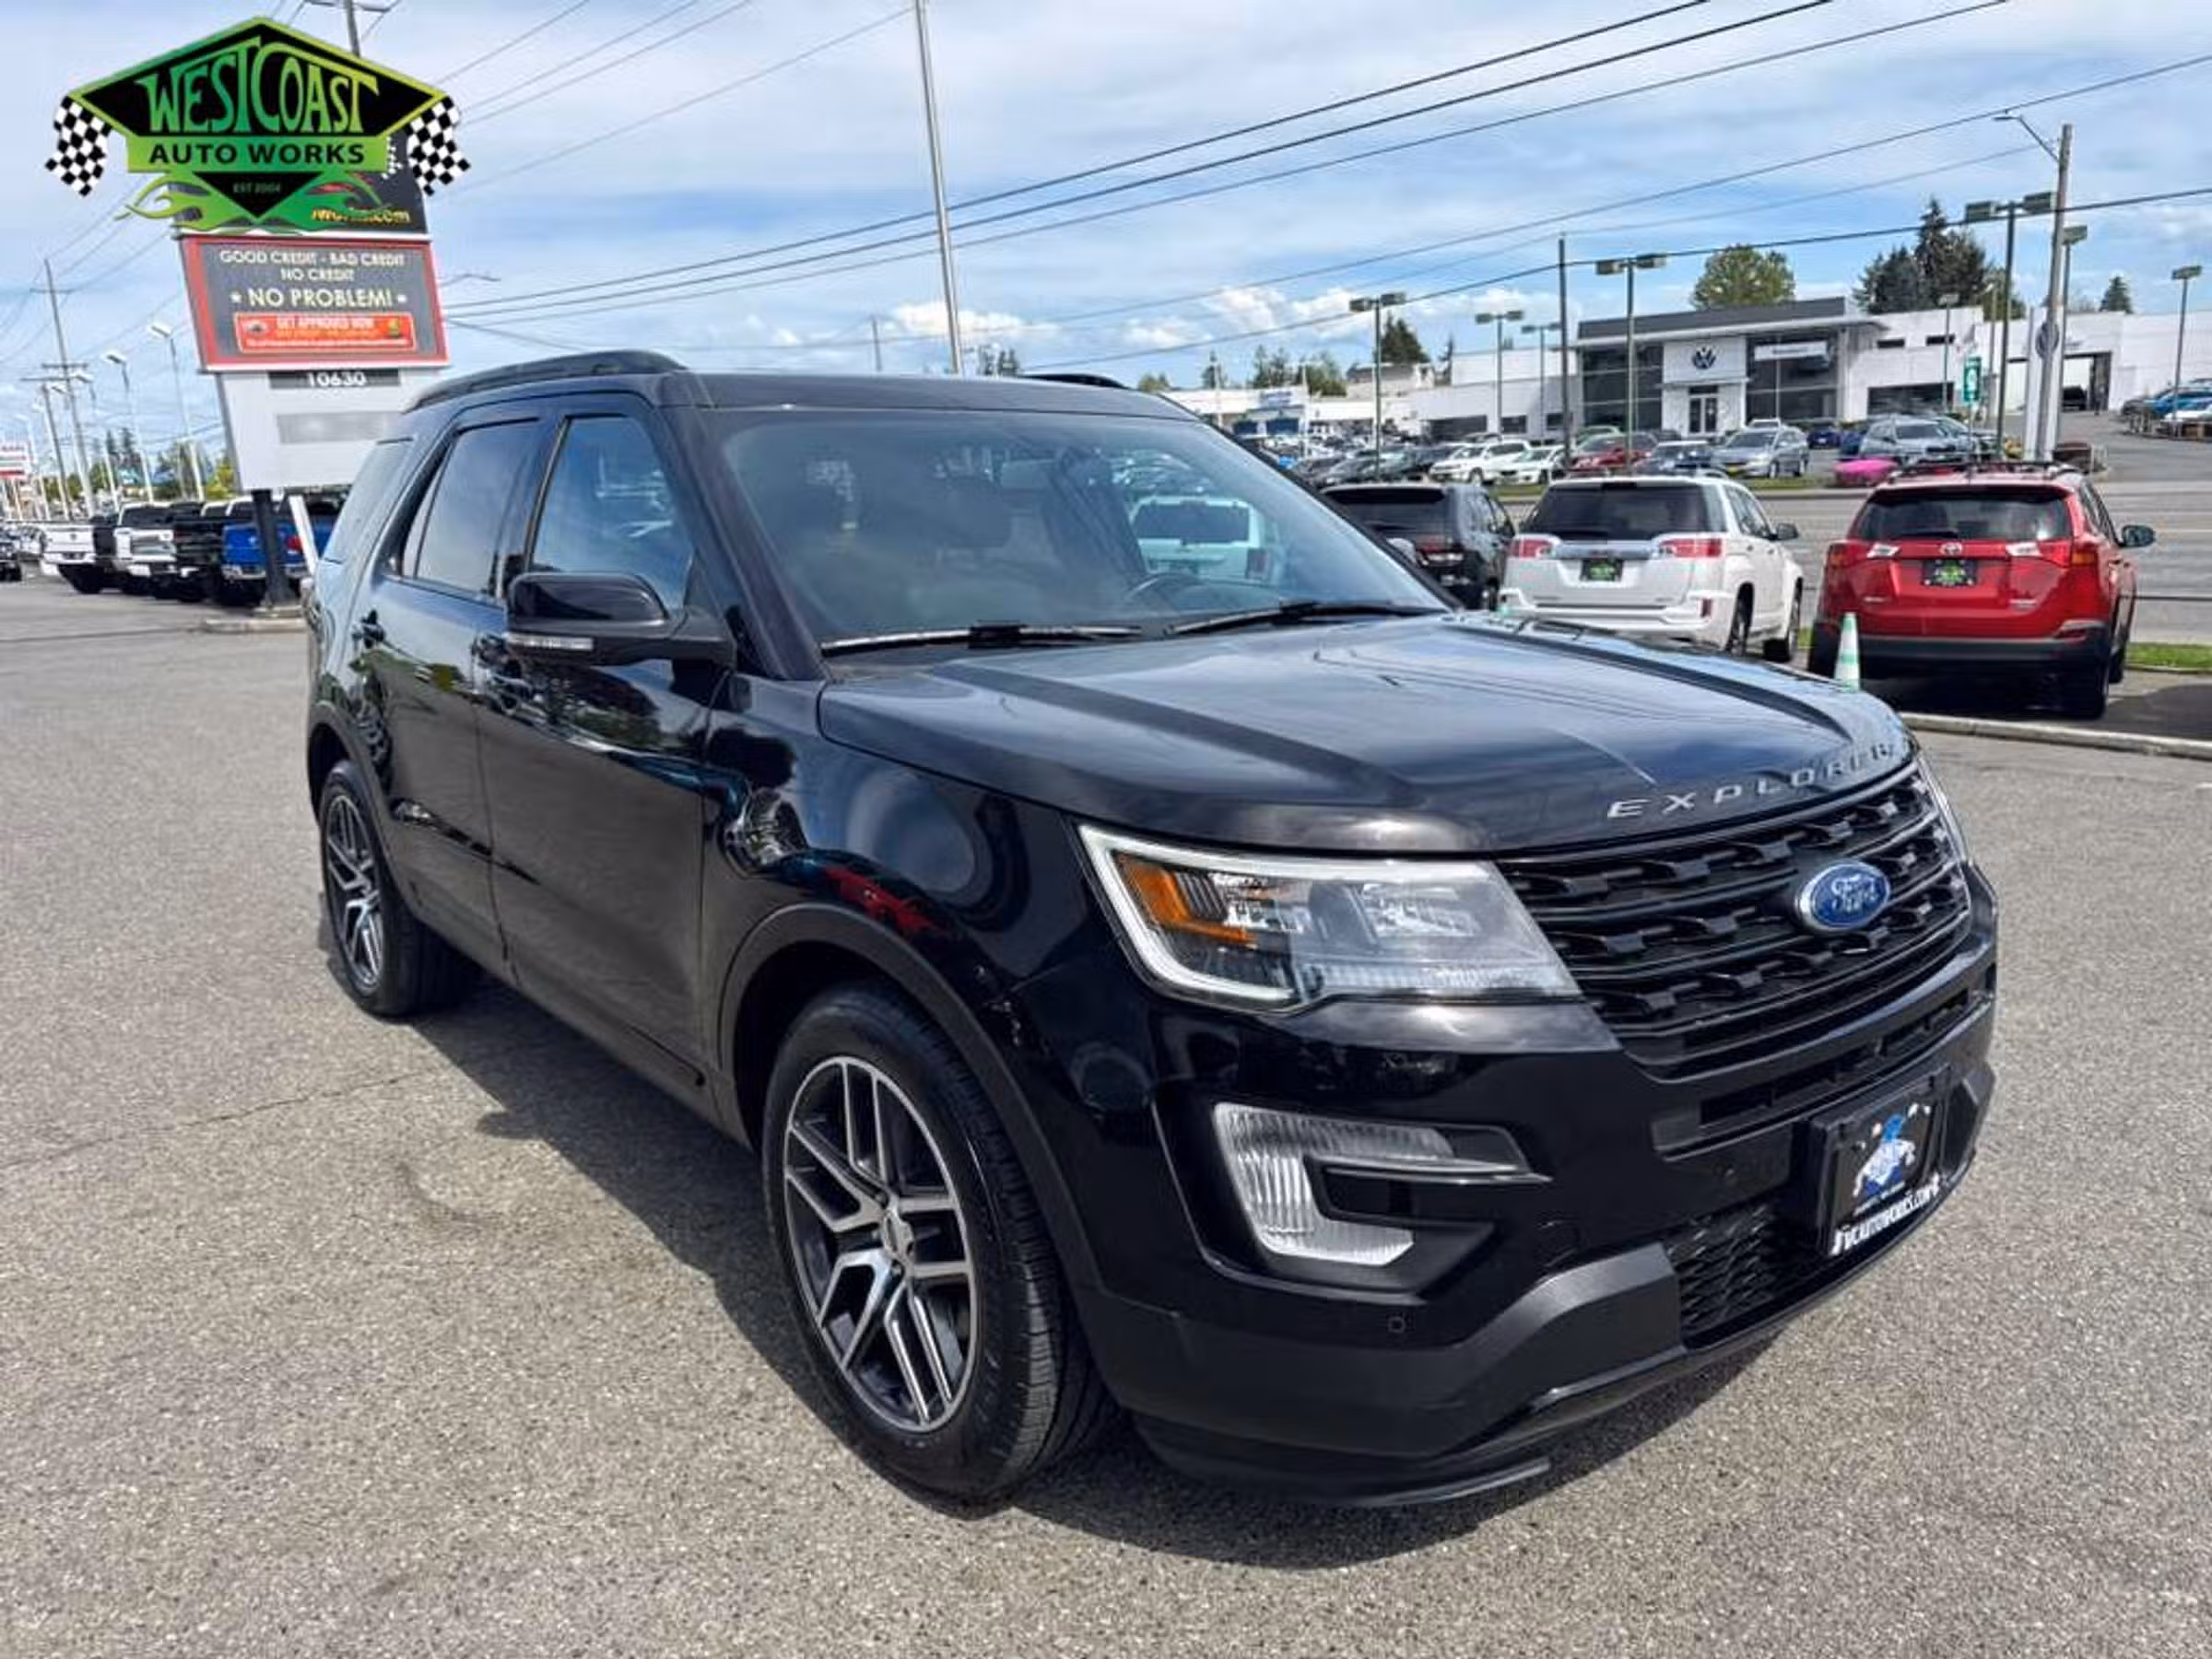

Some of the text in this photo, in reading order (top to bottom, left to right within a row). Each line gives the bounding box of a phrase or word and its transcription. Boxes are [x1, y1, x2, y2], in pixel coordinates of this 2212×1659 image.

[220, 251, 267, 264] GOOD
[271, 252, 317, 265] CREDIT
[330, 253, 358, 265] BAD
[360, 253, 406, 266] CREDIT
[280, 268, 355, 281] NO CREDIT
[248, 288, 393, 309] NO PROBLEM!
[308, 371, 367, 387] 10630
